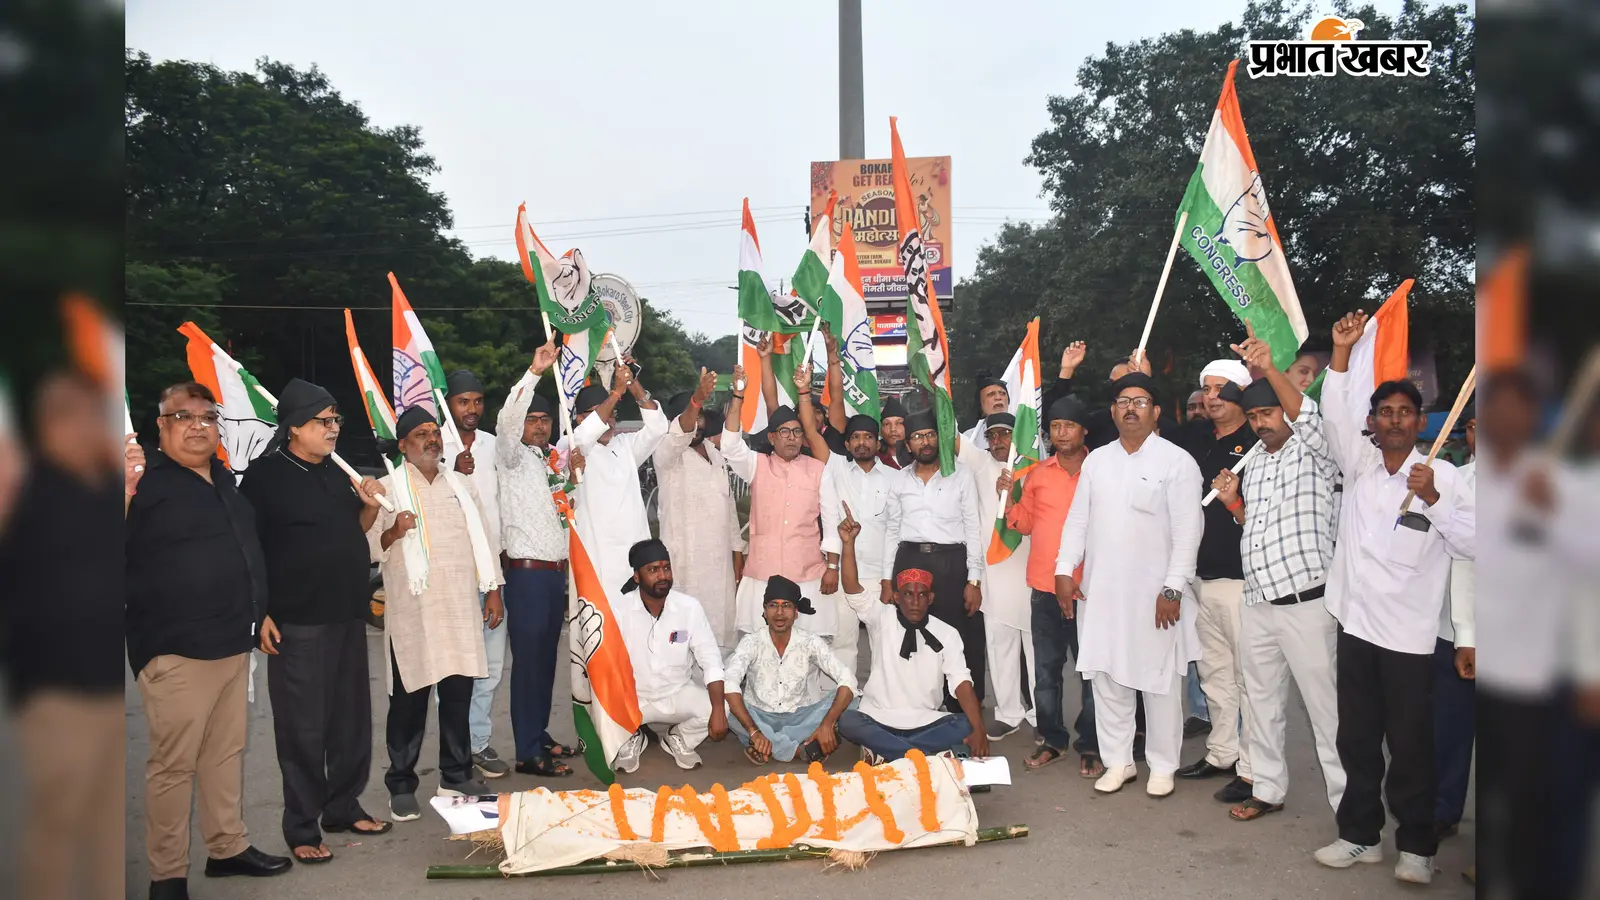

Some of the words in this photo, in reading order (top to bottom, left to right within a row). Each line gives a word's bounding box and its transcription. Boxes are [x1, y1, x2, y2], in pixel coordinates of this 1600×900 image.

[860, 163, 893, 174] BOKAR
[853, 174, 873, 187] GET
[875, 174, 893, 186] REA
[861, 190, 895, 202] SEASON
[842, 207, 896, 230] DANDI
[1191, 226, 1251, 307] CONGRESS
[597, 285, 620, 300] Bokaro
[618, 293, 632, 312] Steel
[623, 310, 633, 324] City
